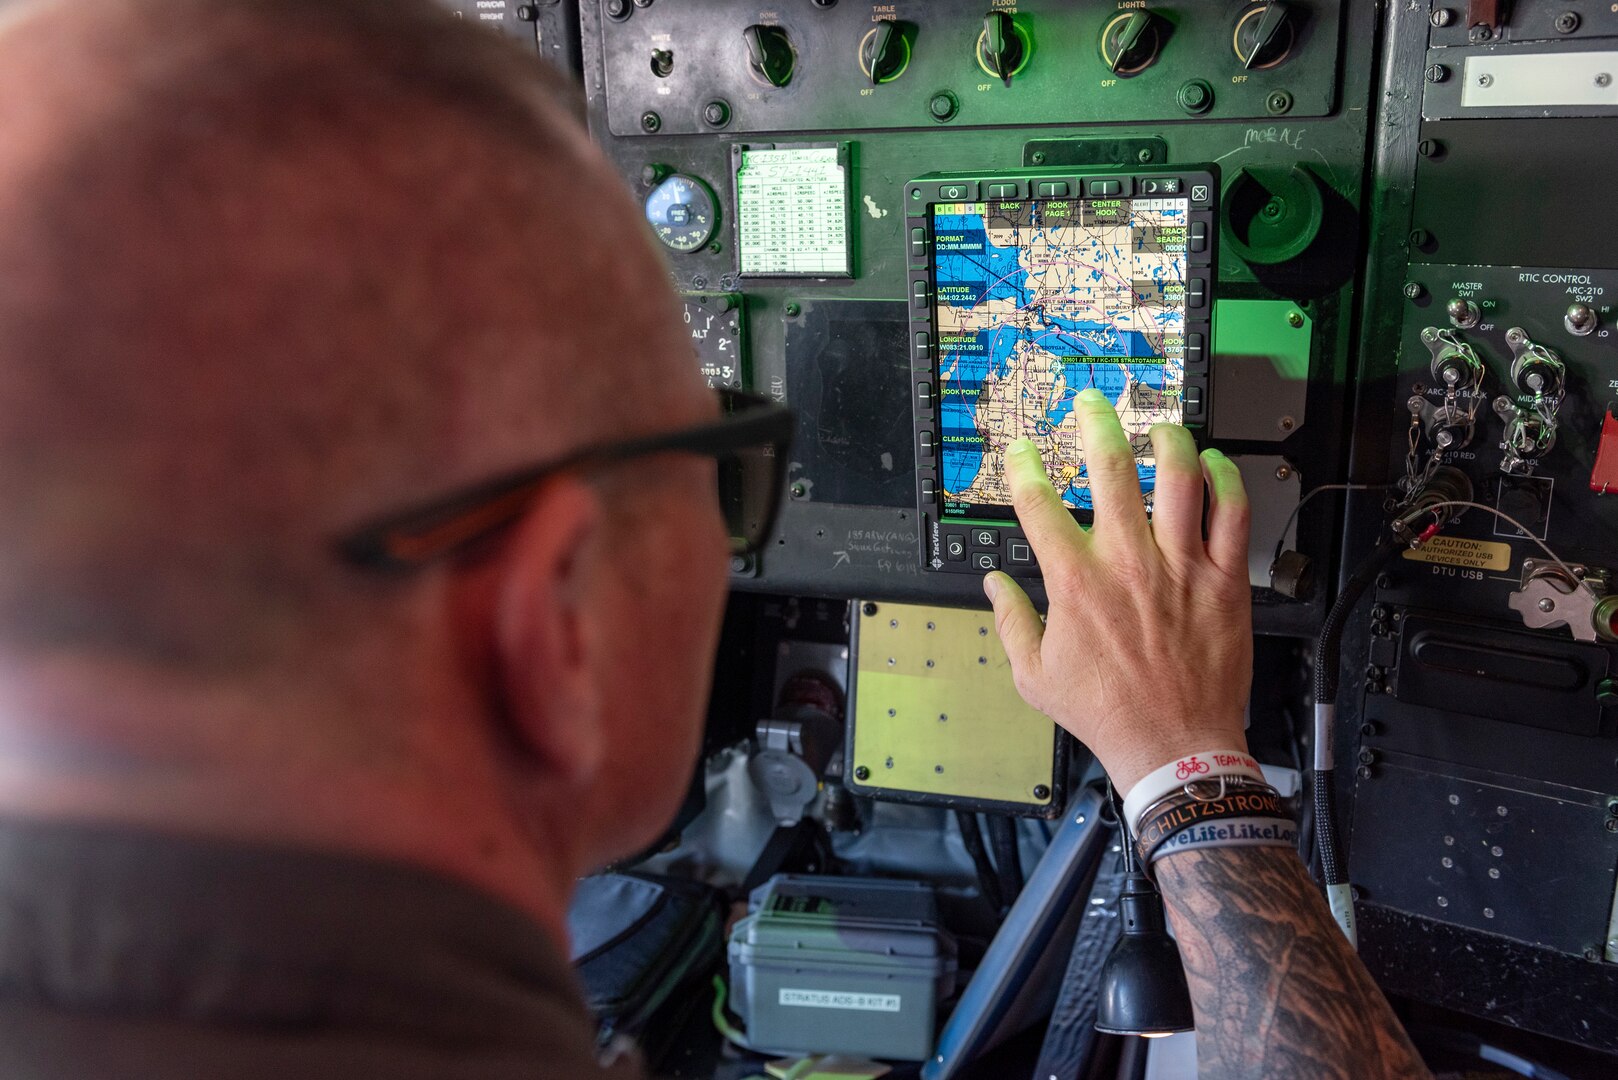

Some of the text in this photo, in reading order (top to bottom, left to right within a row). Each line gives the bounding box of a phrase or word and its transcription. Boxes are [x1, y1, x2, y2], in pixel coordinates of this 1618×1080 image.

[1118, 0, 1146, 8] LIGHTS
[1102, 80, 1116, 88] OFF
[1232, 76, 1248, 84] OFF
[860, 88, 874, 96] OFF
[978, 84, 992, 92] OFF
[1518, 273, 1592, 285] RTIC CONTROL
[1452, 282, 1482, 291] MASTER
[1566, 286, 1603, 296] ARC-210
[1458, 289, 1474, 297] SW1
[1575, 295, 1593, 303] SW2
[1482, 300, 1496, 308] ON
[1480, 323, 1494, 331] OFF
[692, 330, 708, 338] ALT
[718, 338, 726, 350] 2
[722, 366, 731, 378] 3
[1461, 451, 1475, 460] RED
[1432, 537, 1482, 551] CAUTION:
[1475, 551, 1494, 560] USB
[1425, 555, 1486, 567] DEVICES ONLY
[1432, 566, 1484, 580] DTU USB
[1213, 755, 1242, 767] TEAM
[784, 993, 828, 1002] STRATUS
[868, 998, 882, 1006] KIT
